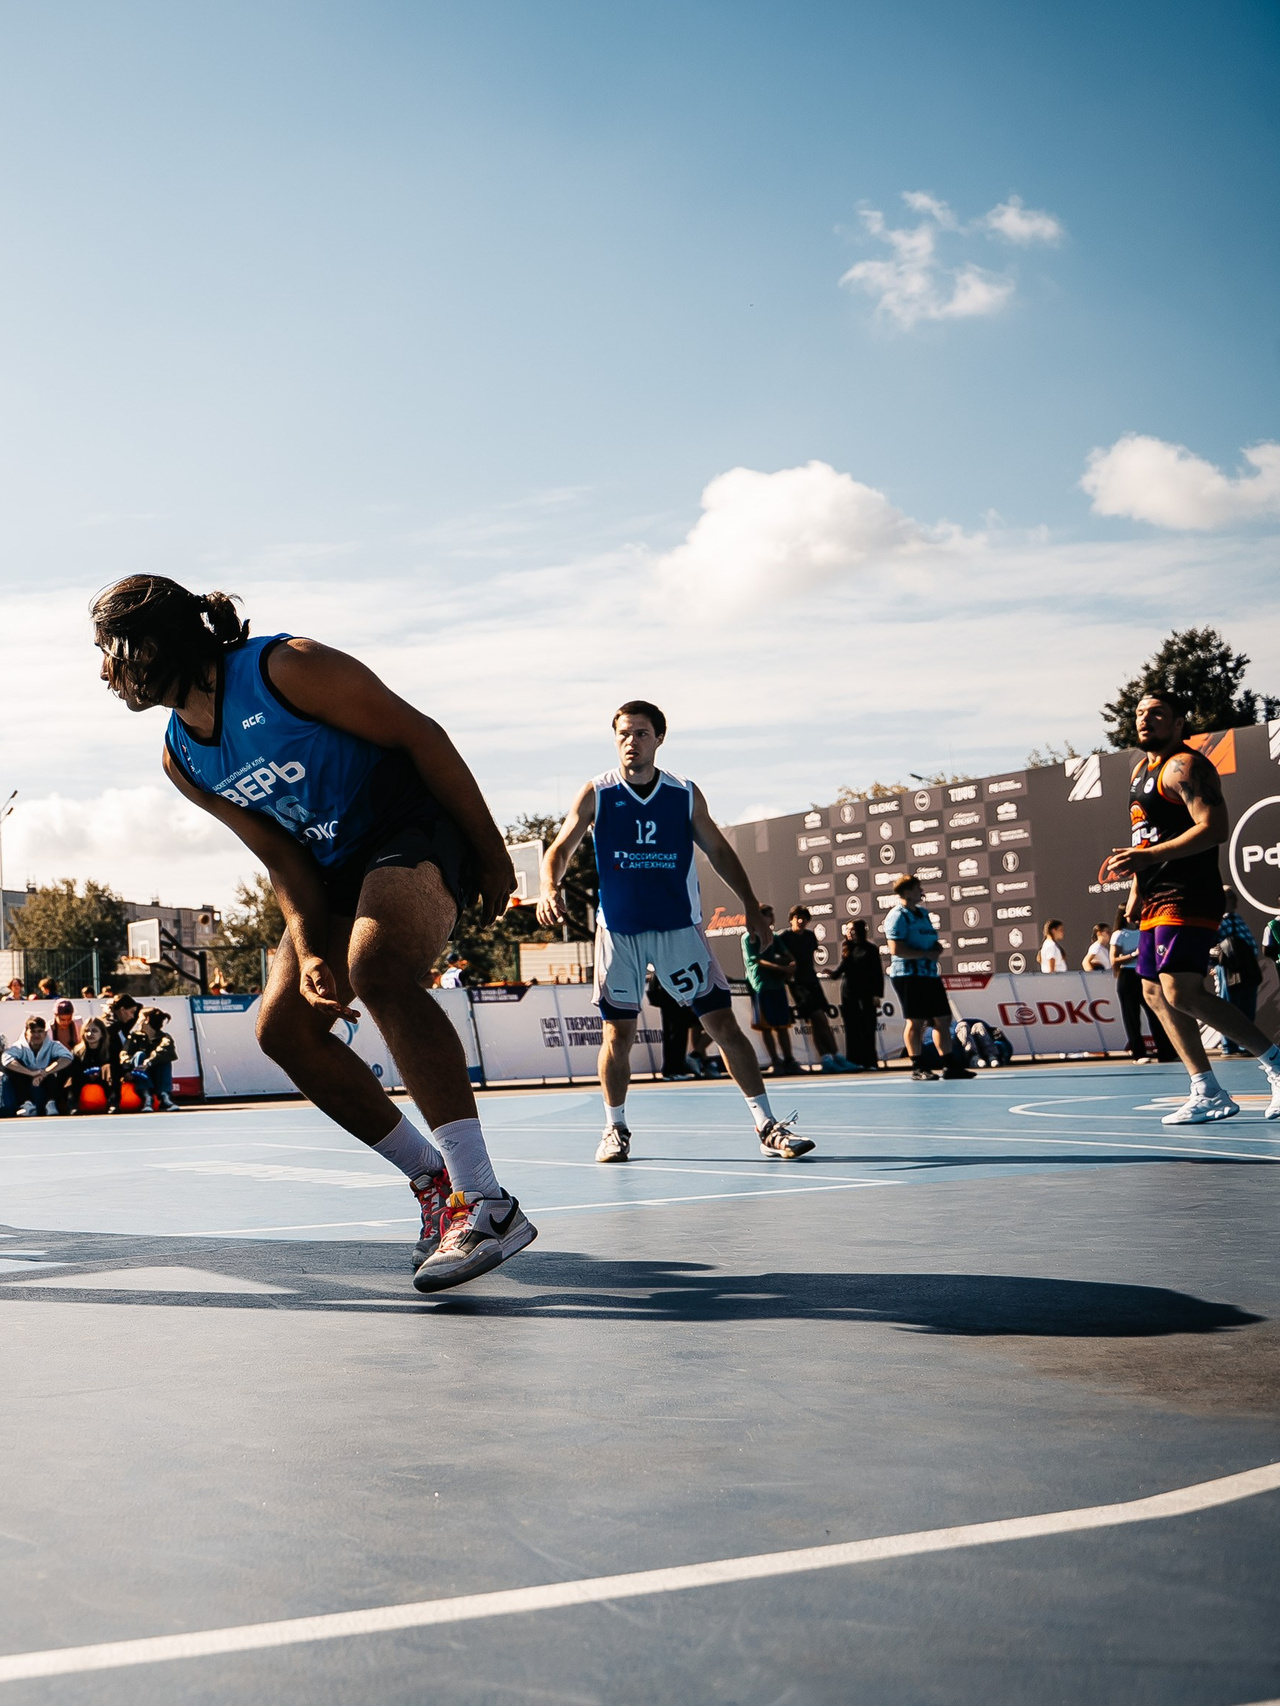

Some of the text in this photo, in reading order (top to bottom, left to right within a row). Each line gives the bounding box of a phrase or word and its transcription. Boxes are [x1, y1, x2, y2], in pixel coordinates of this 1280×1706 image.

[251, 756, 266, 770] КЛУБ
[217, 761, 306, 808] ВЕРЬ
[636, 819, 657, 844] 12
[670, 962, 704, 994] 51
[1037, 999, 1115, 1025] DKC
